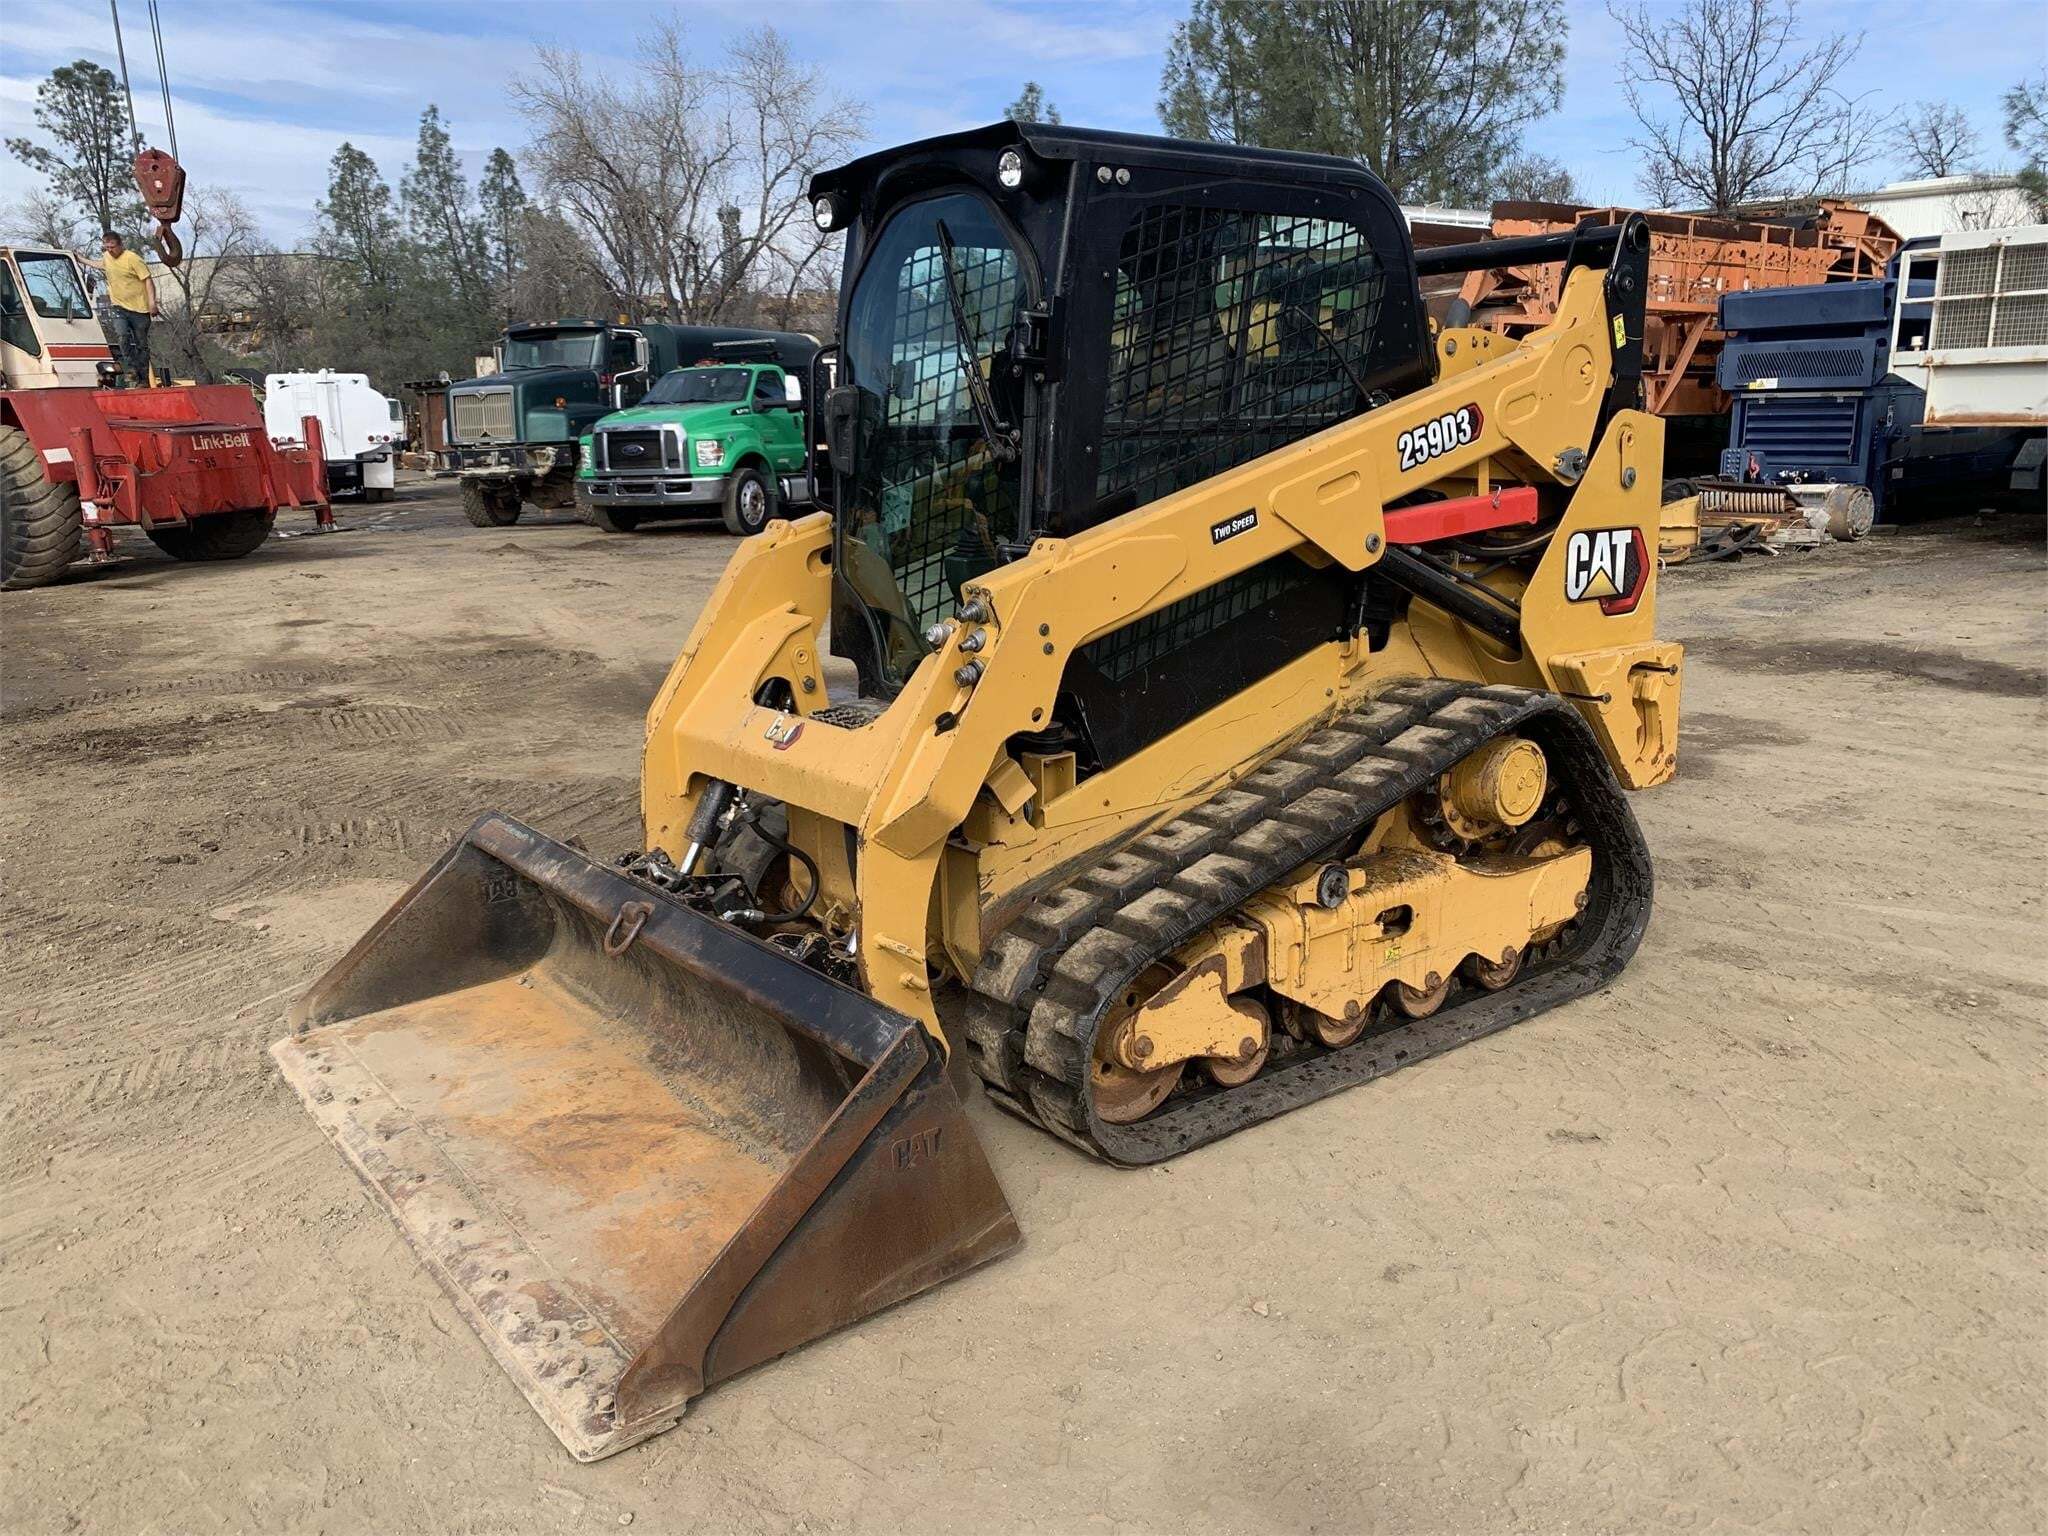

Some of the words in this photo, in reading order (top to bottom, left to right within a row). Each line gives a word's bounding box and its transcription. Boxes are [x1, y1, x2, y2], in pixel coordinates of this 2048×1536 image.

[191, 432, 251, 450] Link-Belt
[1398, 408, 1472, 470] 259D3
[1566, 529, 1632, 600] CAT
